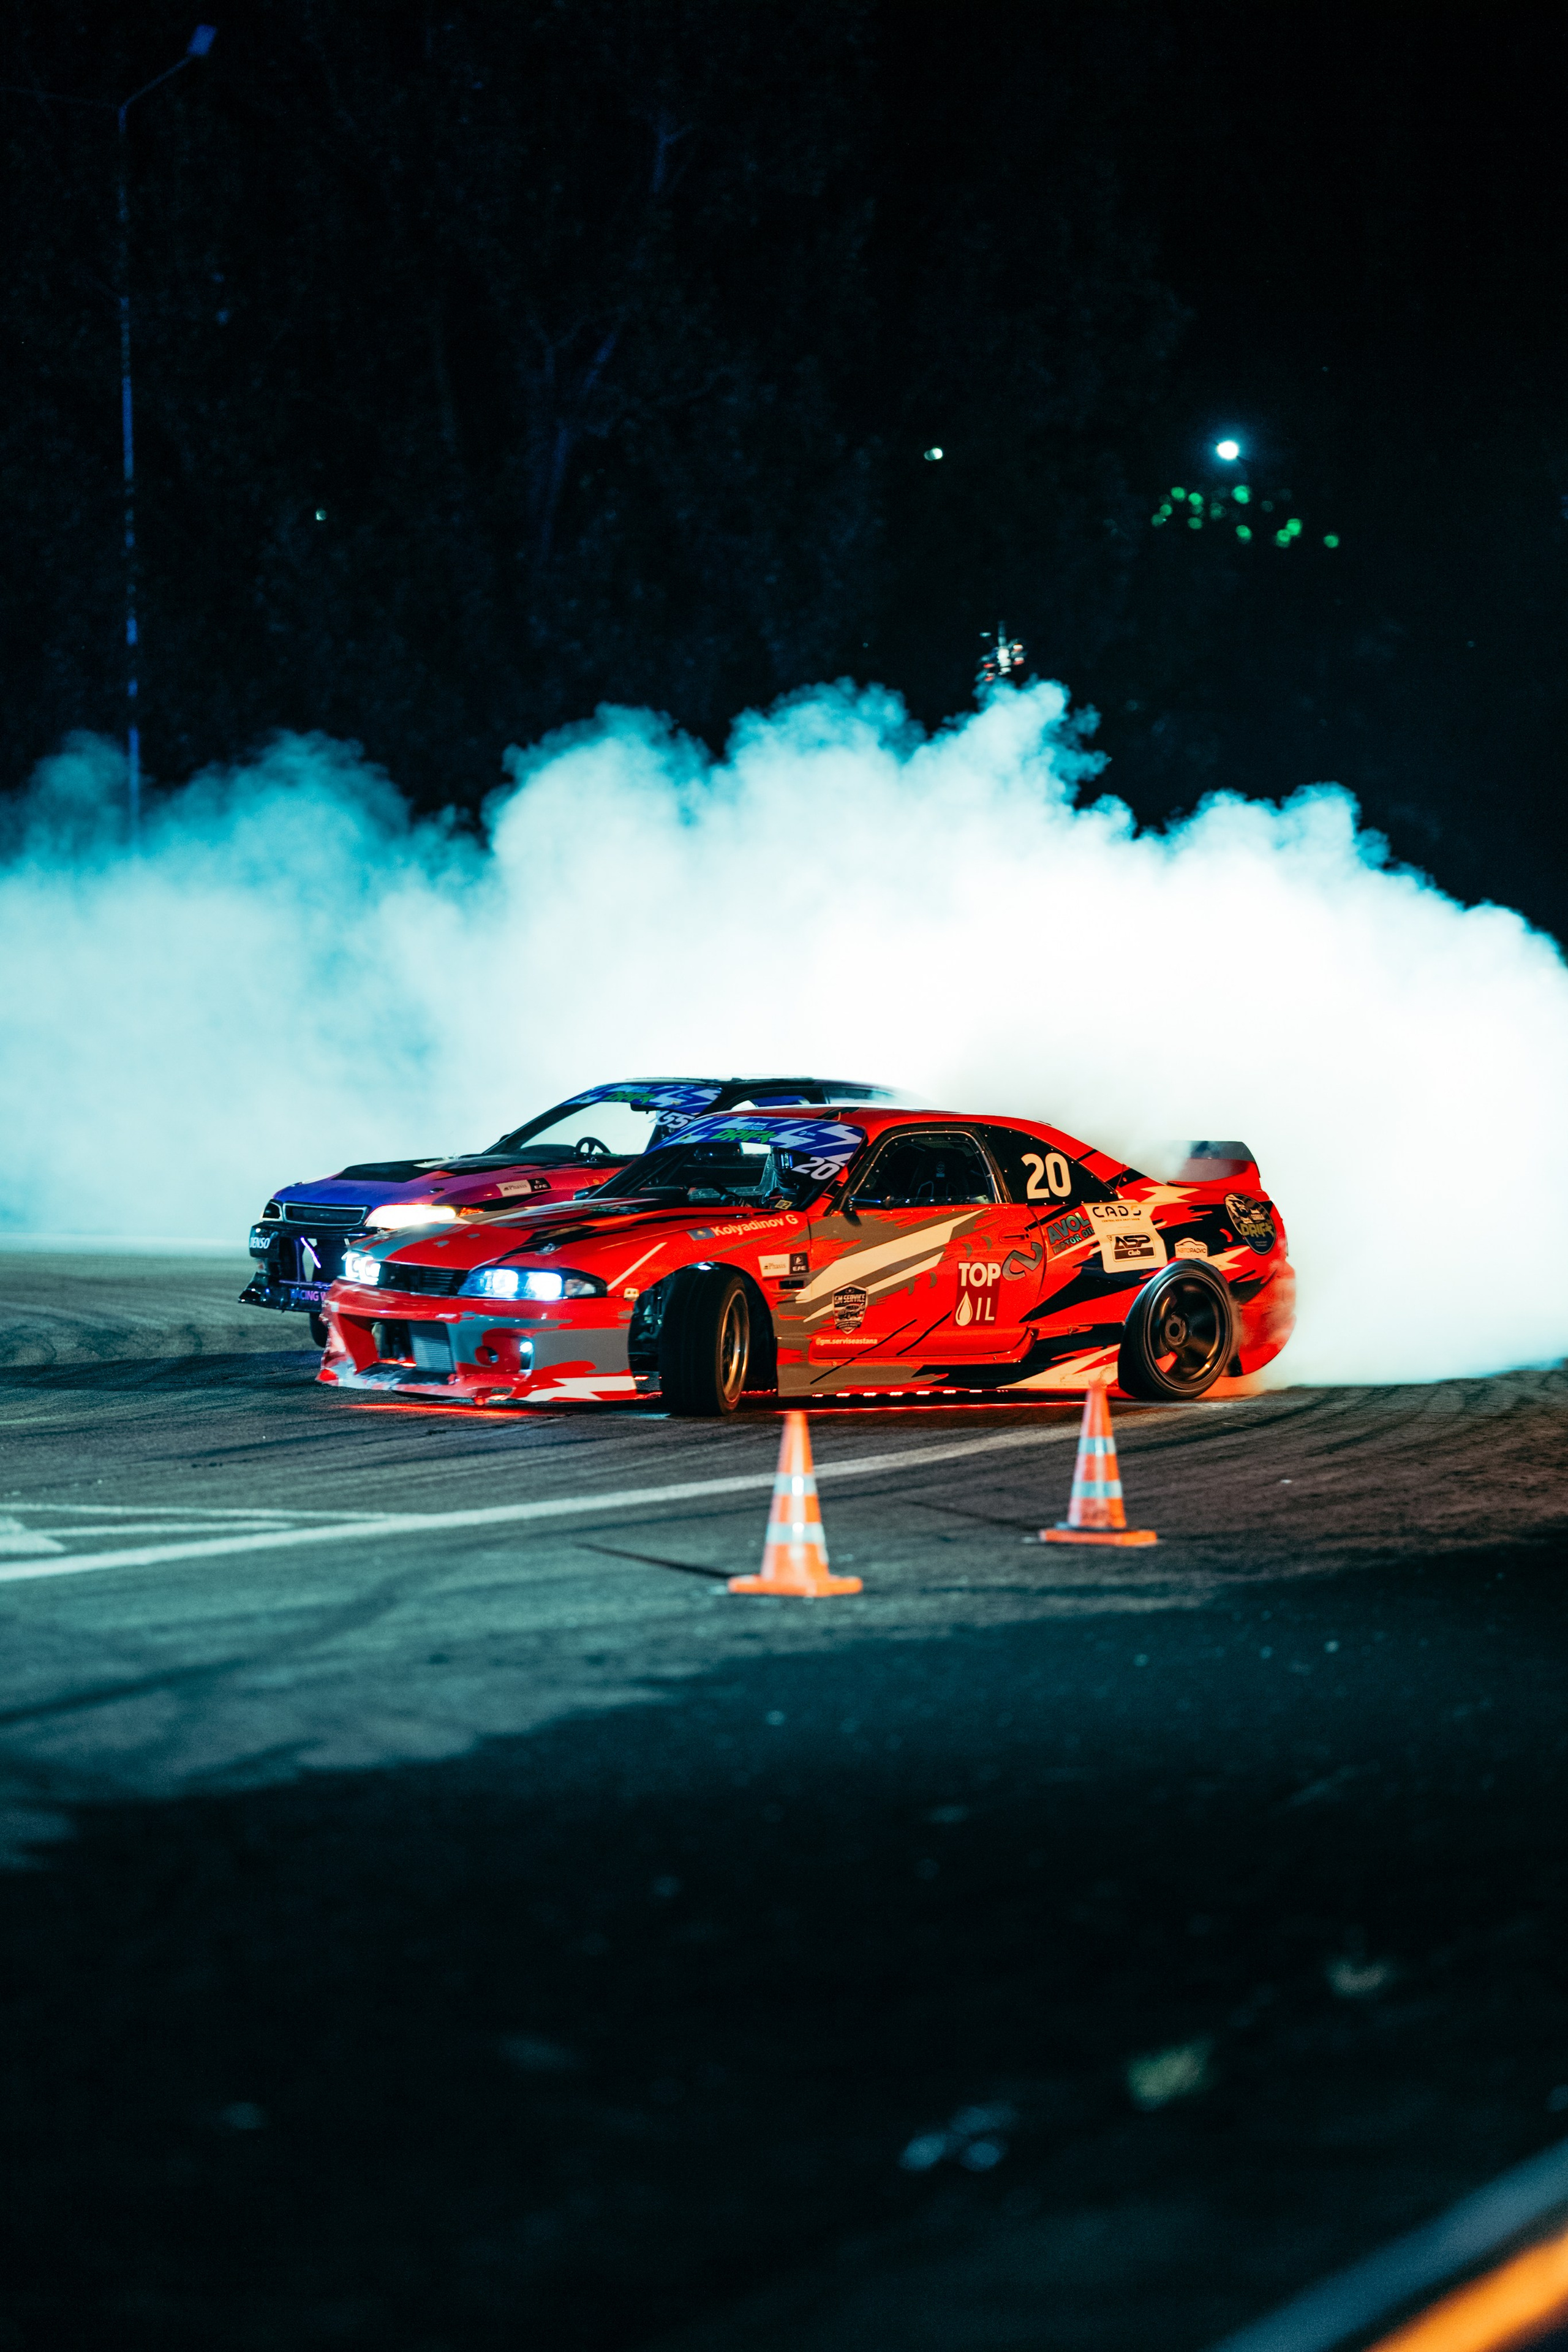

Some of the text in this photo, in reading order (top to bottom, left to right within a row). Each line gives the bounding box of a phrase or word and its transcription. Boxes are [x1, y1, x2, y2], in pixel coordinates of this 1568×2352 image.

[792, 1156, 840, 1180] 20
[1020, 1153, 1071, 1199] 20
[710, 1214, 799, 1236] Kolyadinov G
[1114, 1234, 1152, 1250] ASP
[959, 1262, 1001, 1287] TOP
